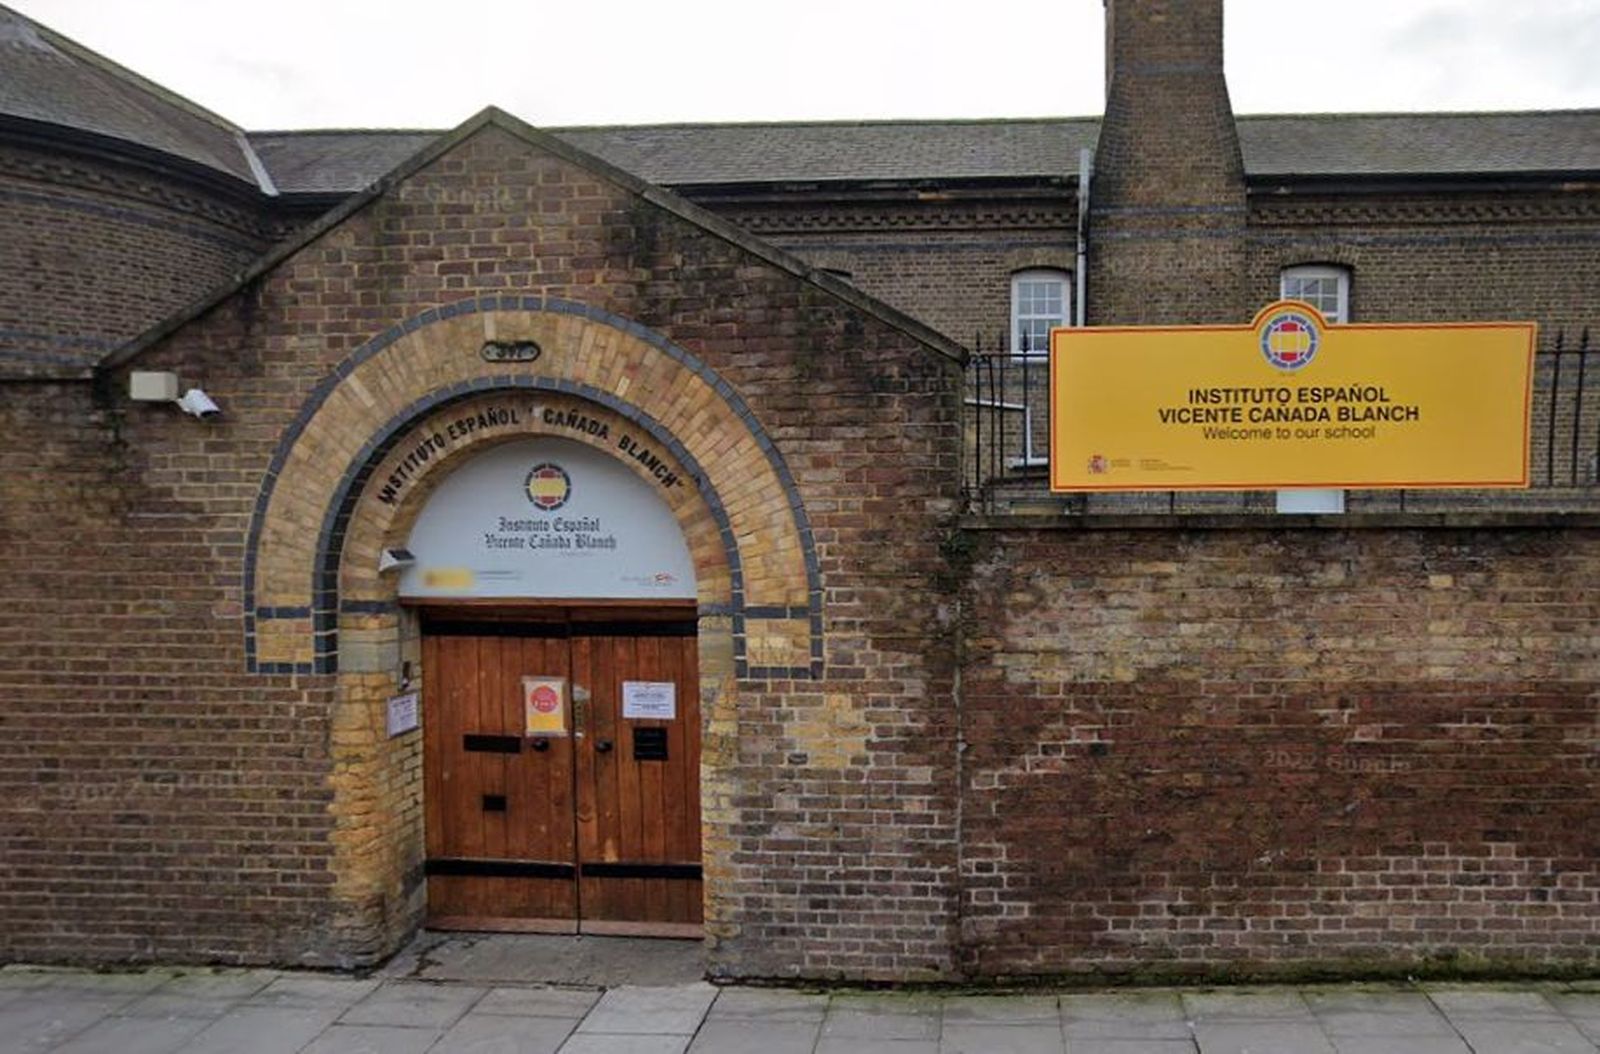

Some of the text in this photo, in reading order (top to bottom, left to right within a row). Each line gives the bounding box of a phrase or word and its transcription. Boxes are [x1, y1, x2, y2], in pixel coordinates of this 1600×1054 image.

[1188, 382, 1390, 405] INSTITUTO ESPAÑOL
[1158, 403, 1420, 424] VICENTE CAÑADA BLANCH
[1203, 424, 1376, 440] Welcome to our school
[377, 432, 445, 504] INSTITUTO
[446, 406, 519, 440] ESPAÑOL
[498, 516, 600, 533] Instituto Español
[485, 533, 617, 550] Vicente Cañada Blanch
